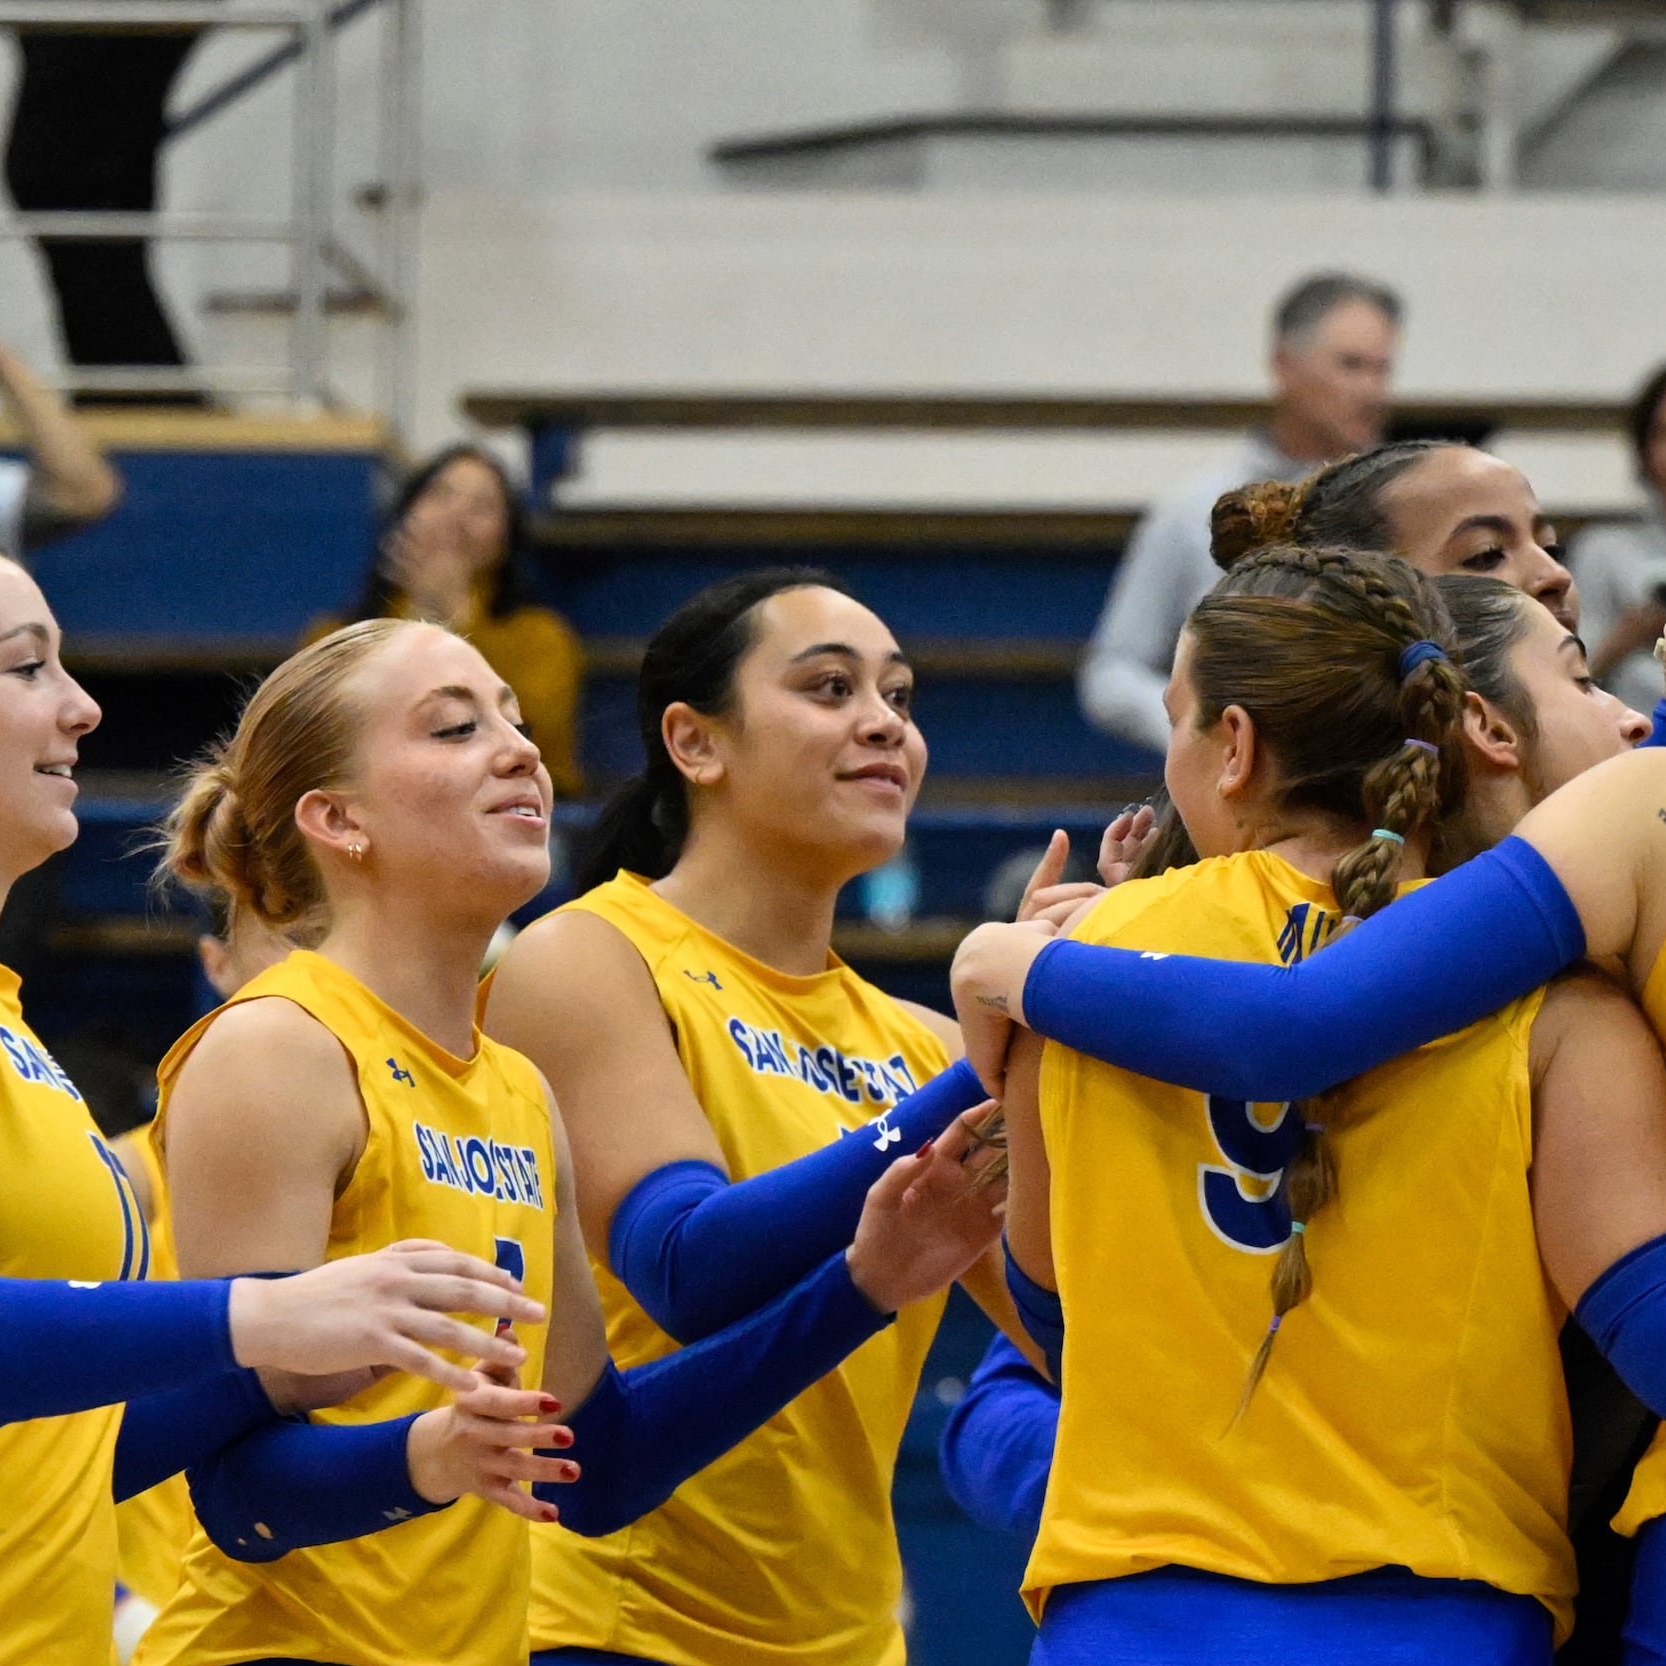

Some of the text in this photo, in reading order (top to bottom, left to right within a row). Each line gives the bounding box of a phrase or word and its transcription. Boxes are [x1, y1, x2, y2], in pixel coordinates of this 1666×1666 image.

[727, 1016, 794, 1077] SAN
[413, 1120, 463, 1191] SAN
[1196, 1094, 1292, 1255] 9
